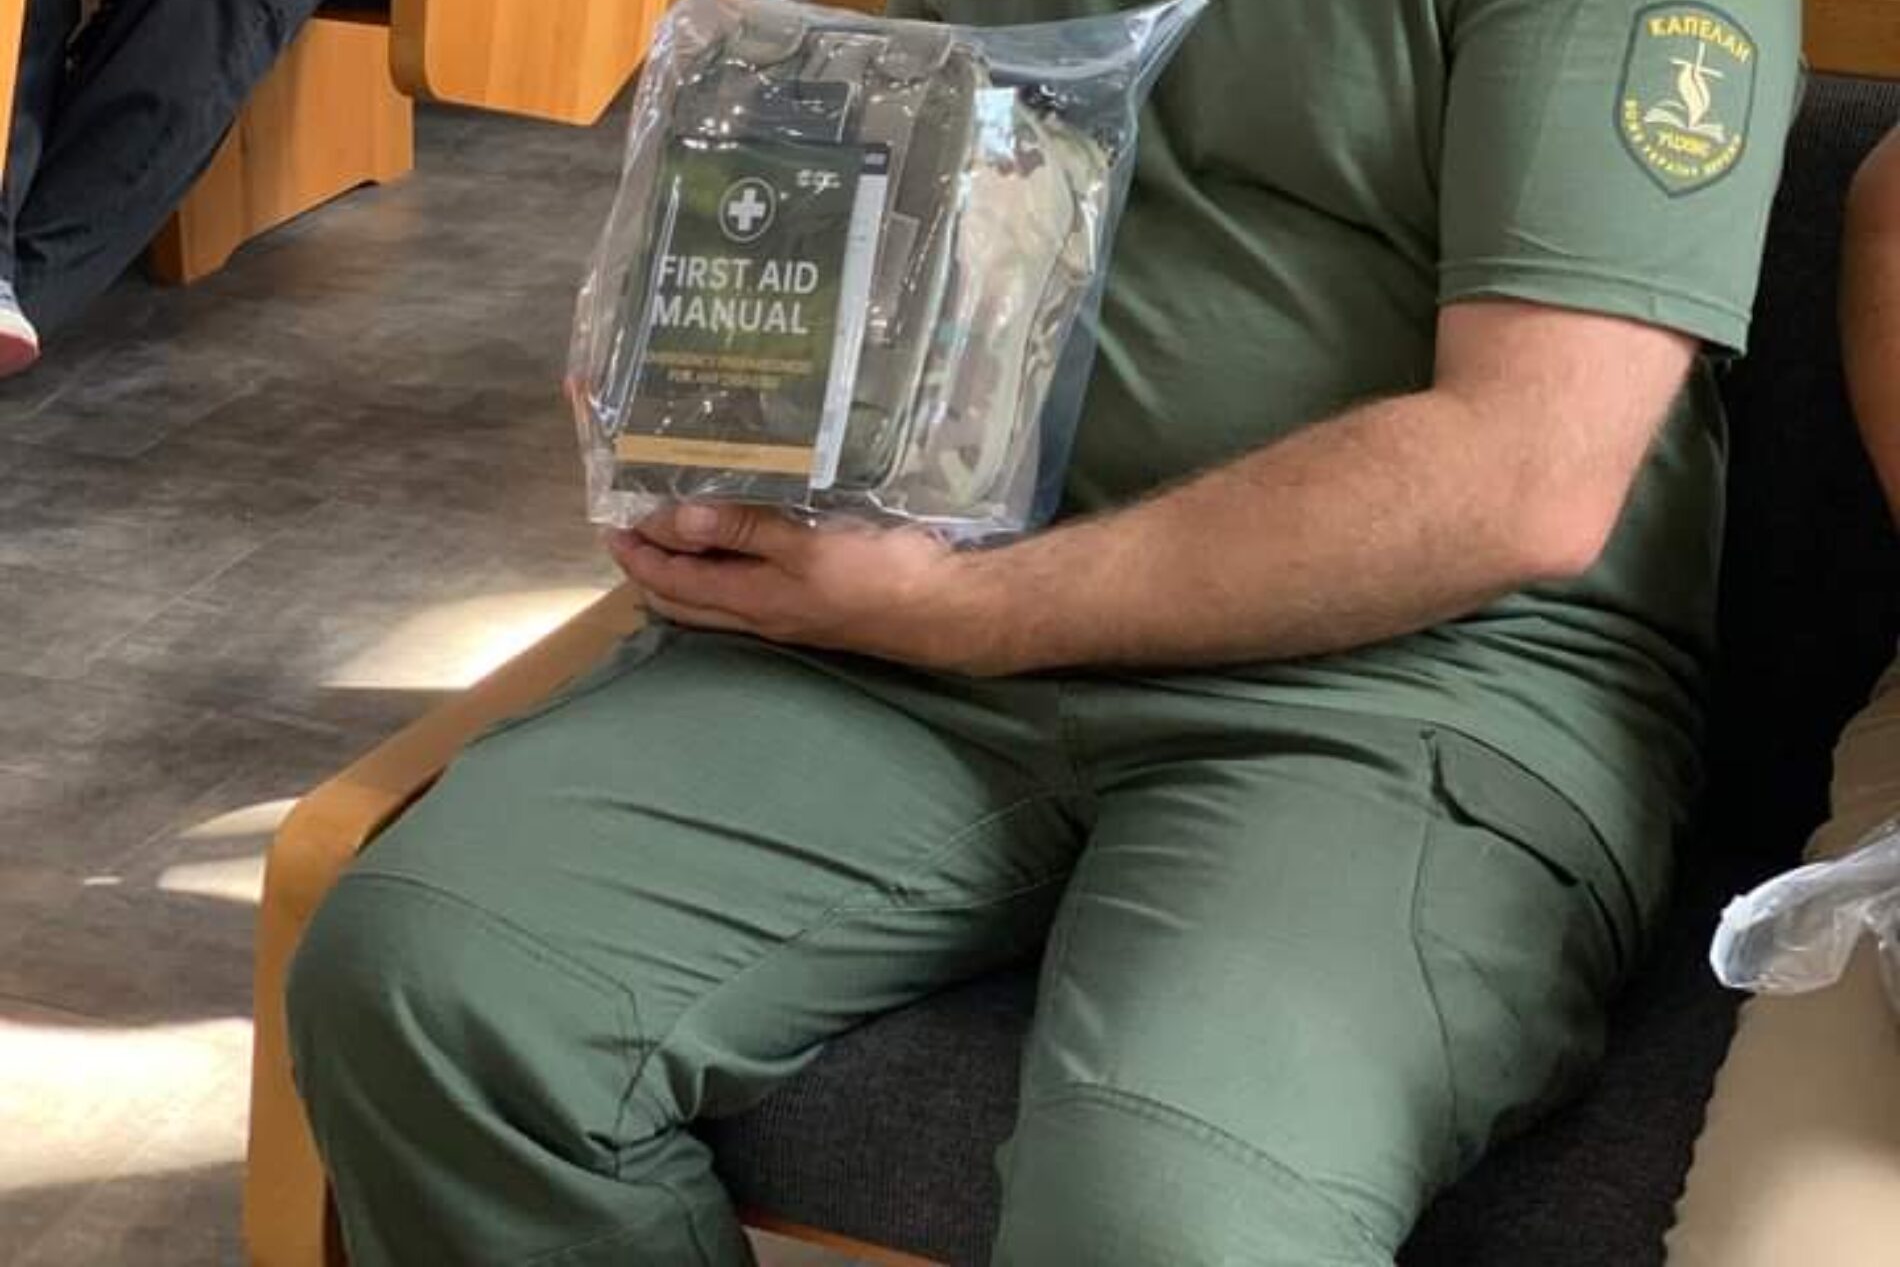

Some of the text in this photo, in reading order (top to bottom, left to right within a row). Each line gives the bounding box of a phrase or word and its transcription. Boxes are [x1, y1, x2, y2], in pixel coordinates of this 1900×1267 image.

[1647, 15, 1750, 62] КАПЕЛАН
[656, 255, 819, 295] FIRST AID
[650, 295, 808, 334] MANUAL
